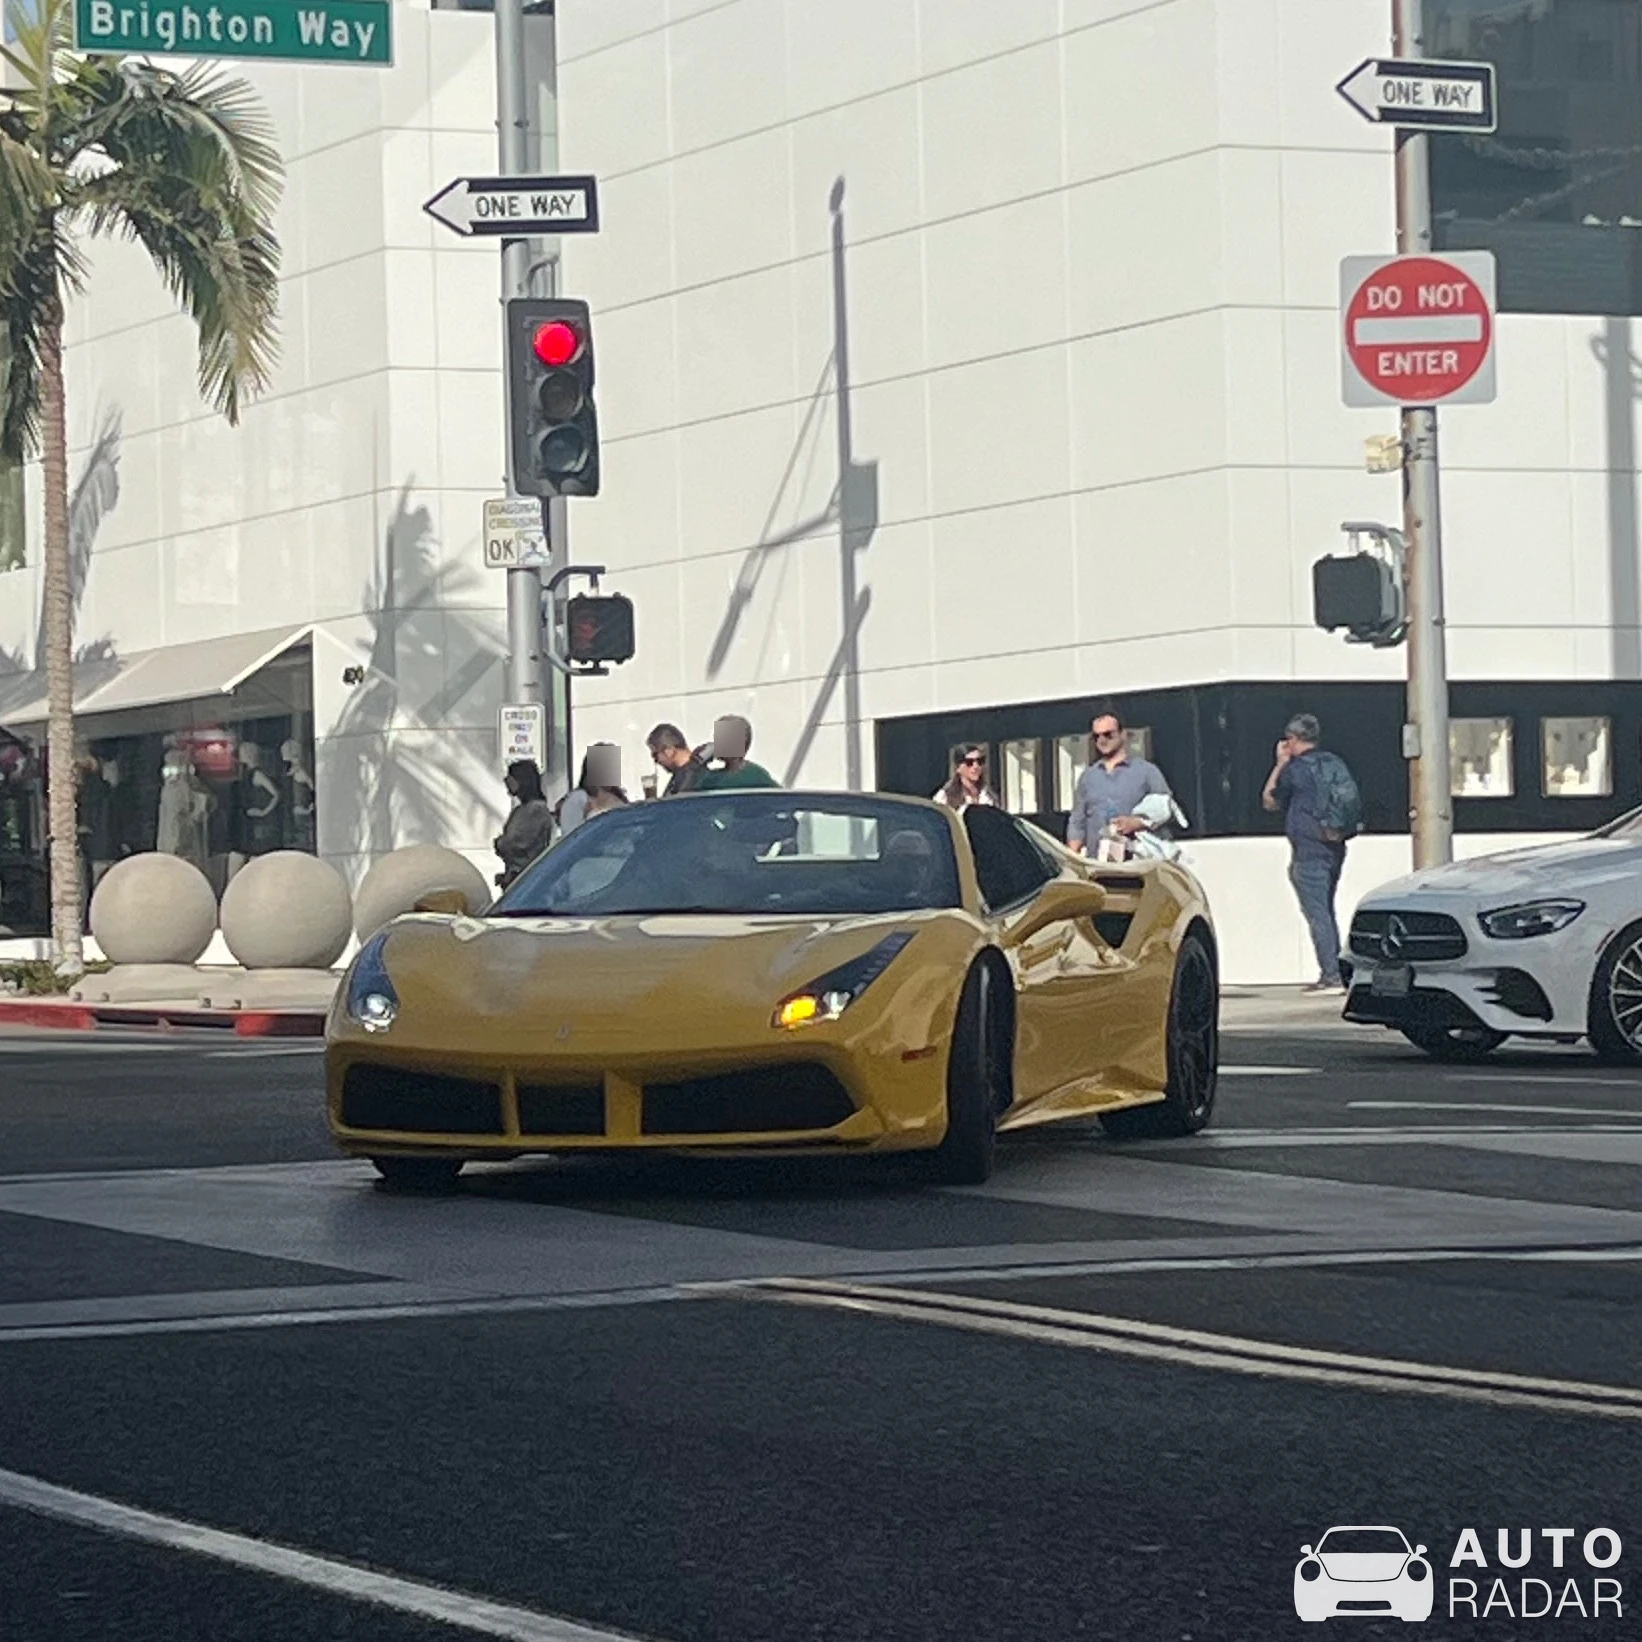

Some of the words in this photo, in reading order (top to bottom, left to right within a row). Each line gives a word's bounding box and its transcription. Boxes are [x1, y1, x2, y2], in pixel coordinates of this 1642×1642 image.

[90, 0, 274, 50] Brighton
[297, 10, 376, 57] Way
[1383, 80, 1424, 105] ONE
[1432, 83, 1474, 108] WAY
[476, 195, 521, 218] ONE
[530, 194, 576, 217] WAY
[1366, 284, 1402, 311] DO
[1418, 282, 1468, 309] NOT
[1378, 349, 1459, 377] ENTER
[490, 539, 515, 561] OK
